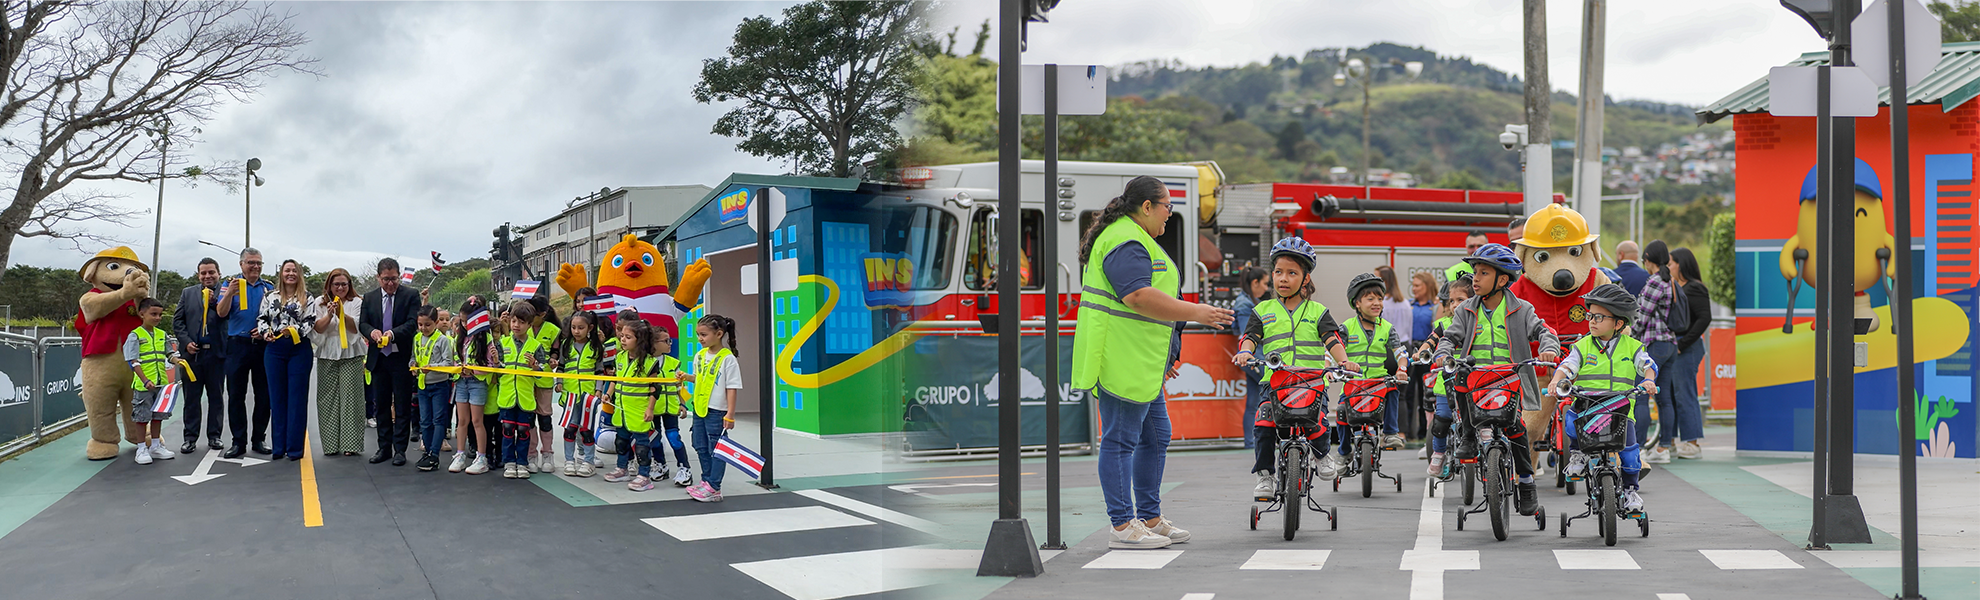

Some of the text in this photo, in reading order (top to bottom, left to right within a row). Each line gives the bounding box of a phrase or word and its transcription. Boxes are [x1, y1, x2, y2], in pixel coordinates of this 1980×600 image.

[721, 191, 748, 214] INS
[864, 258, 913, 293] INS
[15, 385, 31, 402] INS
[46, 379, 69, 395] GRUPO
[915, 382, 1085, 405] GRUPO NS
[1215, 379, 1248, 397] INS
